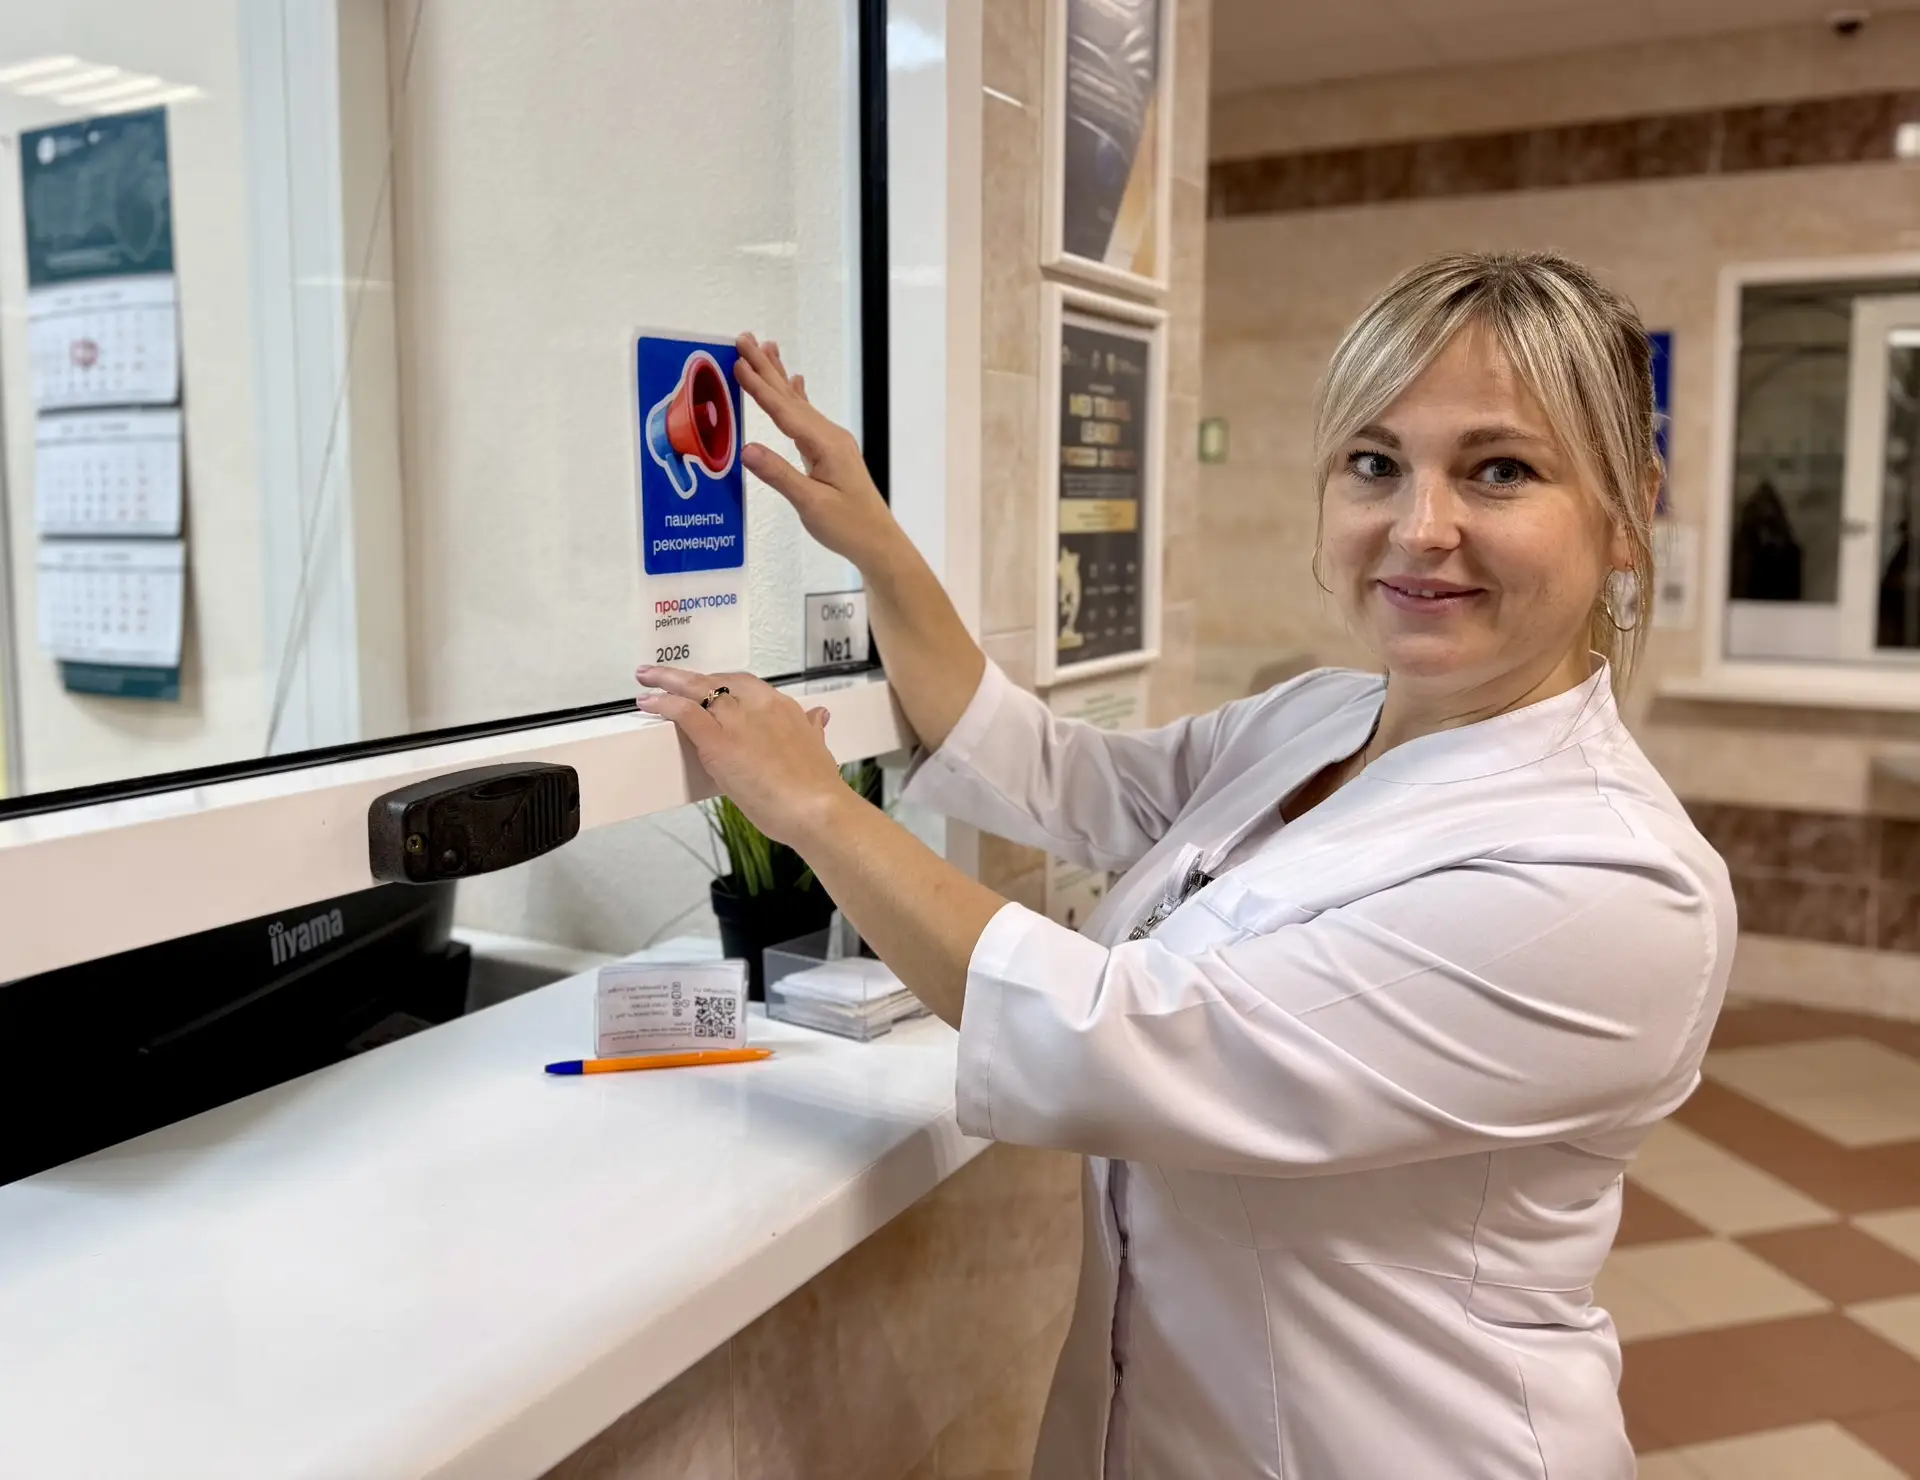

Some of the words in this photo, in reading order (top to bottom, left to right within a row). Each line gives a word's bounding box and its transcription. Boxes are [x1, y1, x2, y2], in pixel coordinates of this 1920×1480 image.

[665, 513, 724, 529] пациенты
[653, 535, 736, 556] рекомендуют
[655, 593, 737, 615] продокторов
[821, 602, 855, 621] ОКНО
[655, 615, 692, 631] рейтинг
[656, 644, 690, 663] 2026
[823, 636, 852, 663] №1
[268, 908, 344, 966] iiyama
